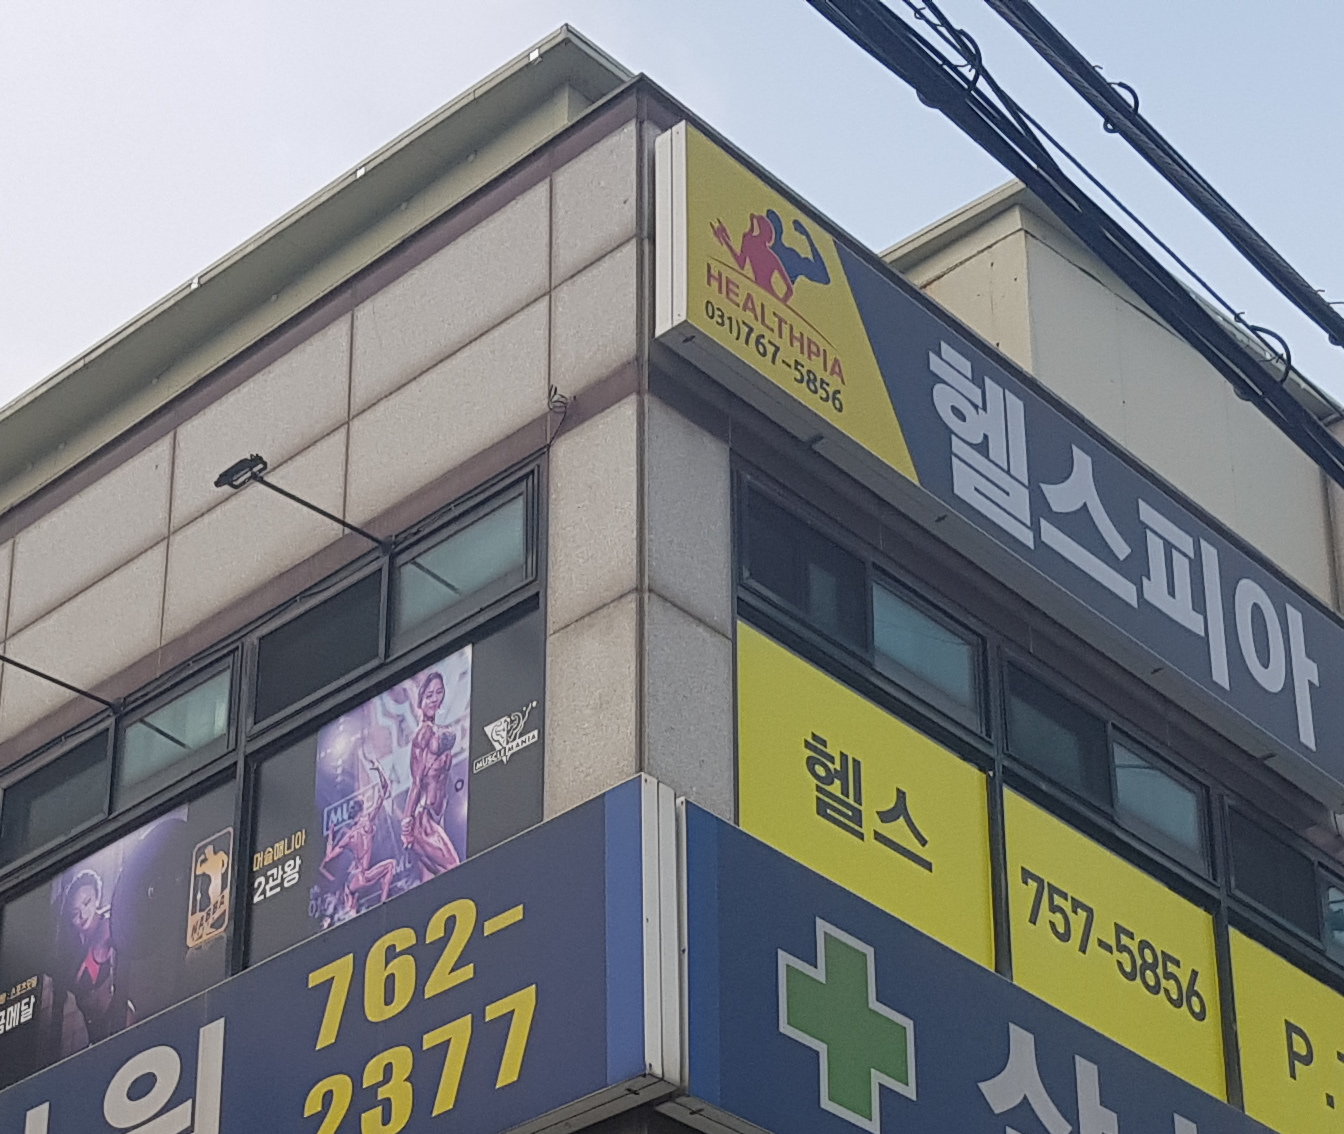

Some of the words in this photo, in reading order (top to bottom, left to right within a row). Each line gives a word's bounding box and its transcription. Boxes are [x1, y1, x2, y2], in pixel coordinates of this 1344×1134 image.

[705, 261, 846, 386] HEALTHPIA
[930, 340, 1320, 752] 헬스피아
[803, 731, 933, 873] 헬스
[254, 856, 301, 904] 2관왕
[1020, 865, 1207, 1023] 757-5856
[305, 896, 526, 1051] 762-
